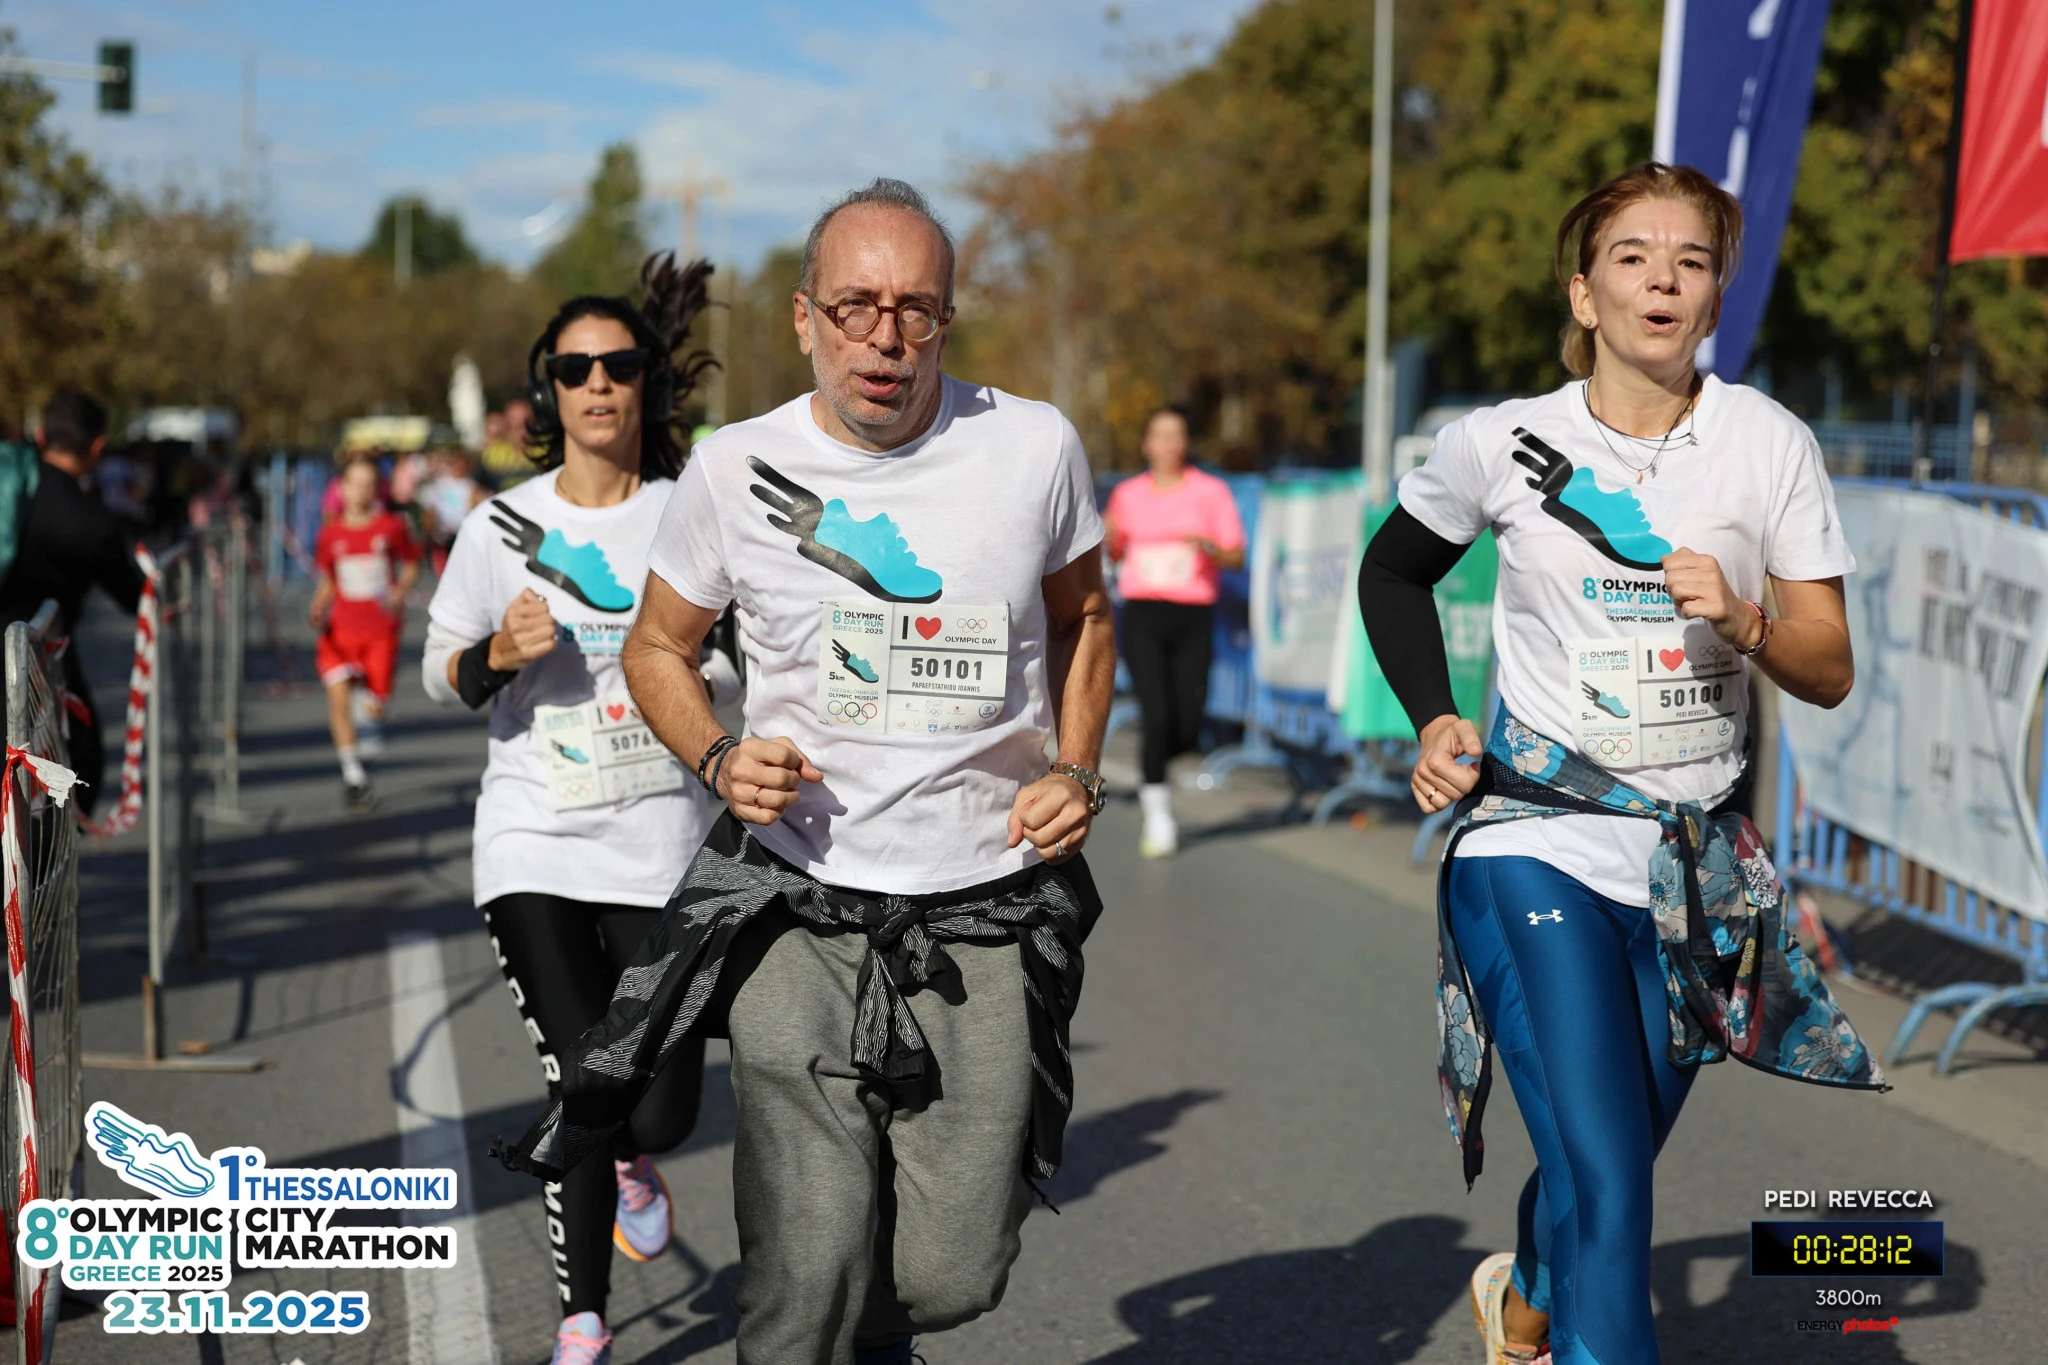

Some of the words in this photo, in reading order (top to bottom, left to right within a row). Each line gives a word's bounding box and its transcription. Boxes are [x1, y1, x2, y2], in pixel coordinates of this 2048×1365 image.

[1603, 591, 1633, 603] DAY
[1639, 592, 1673, 605] RUN
[844, 611, 885, 621] OLYMPIC
[843, 617, 863, 626] DAY
[864, 619, 884, 628] RUN
[580, 624, 629, 633] OLYMPI
[832, 624, 863, 633] GREECE
[865, 627, 884, 635] 2025
[607, 632, 624, 642] RU
[944, 636, 980, 644] OLYMPIC
[981, 637, 998, 645] DAY
[1589, 650, 1628, 658] OLYMPIC
[1609, 657, 1629, 665] RUN
[1689, 662, 1719, 672] OLYMPIC
[1720, 660, 1733, 669] DAY
[910, 657, 982, 681] 50101
[958, 684, 981, 693] IOANNIS
[828, 692, 853, 700] OLYMPIC
[1660, 683, 1723, 708] 50100
[1688, 708, 1708, 718] REVECCA
